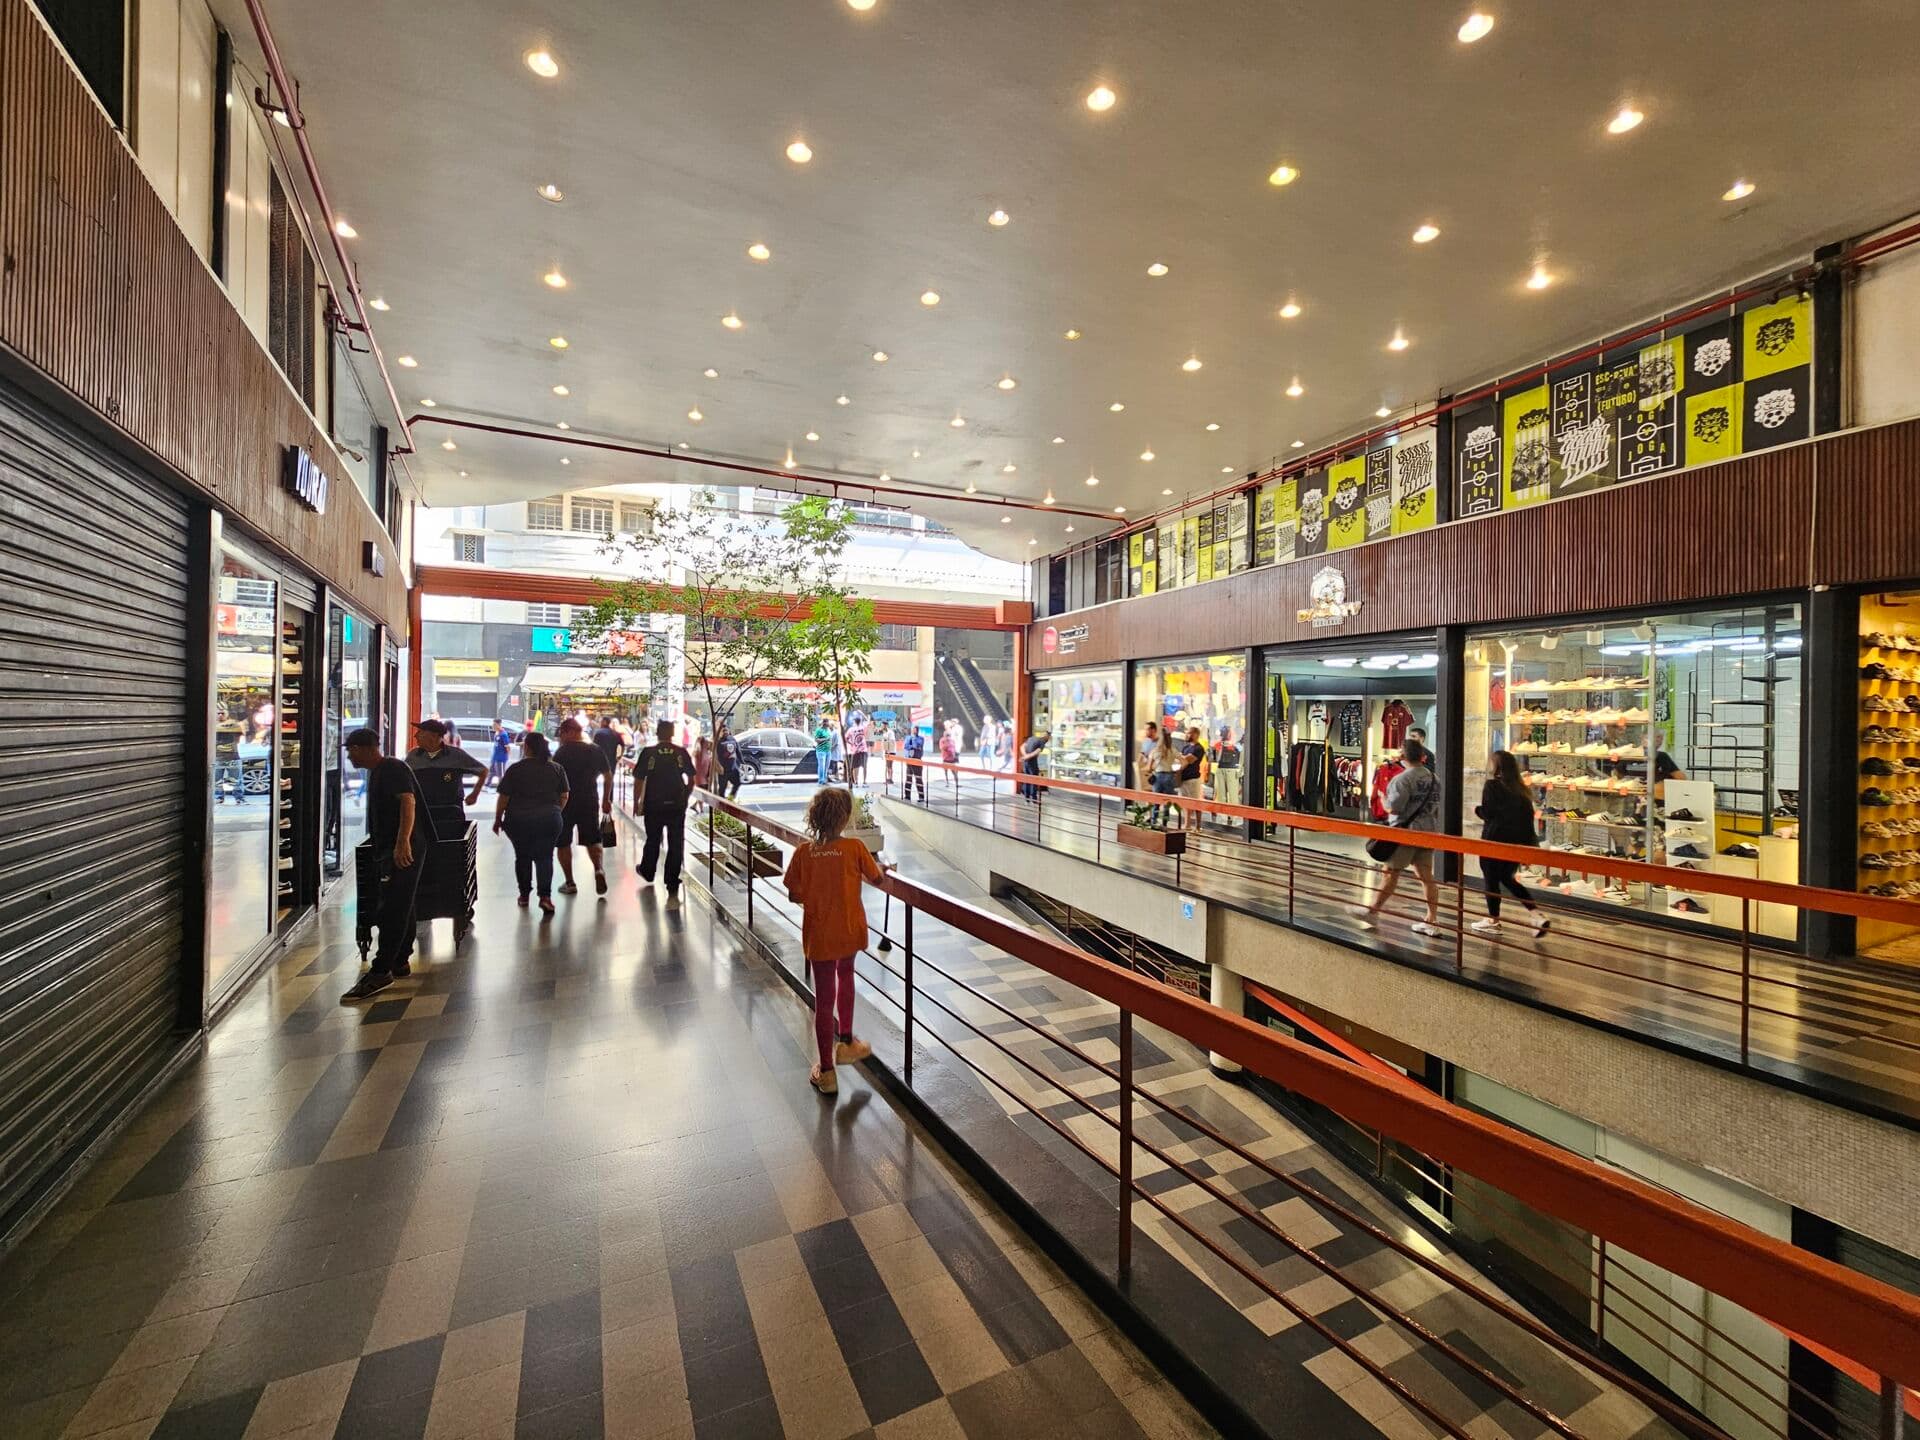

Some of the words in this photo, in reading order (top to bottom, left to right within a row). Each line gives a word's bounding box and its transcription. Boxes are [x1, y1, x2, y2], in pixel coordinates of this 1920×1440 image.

[1466, 453, 1494, 469] JOGA
[1628, 441, 1666, 463] JOGA
[1466, 485, 1494, 503] JOGA
